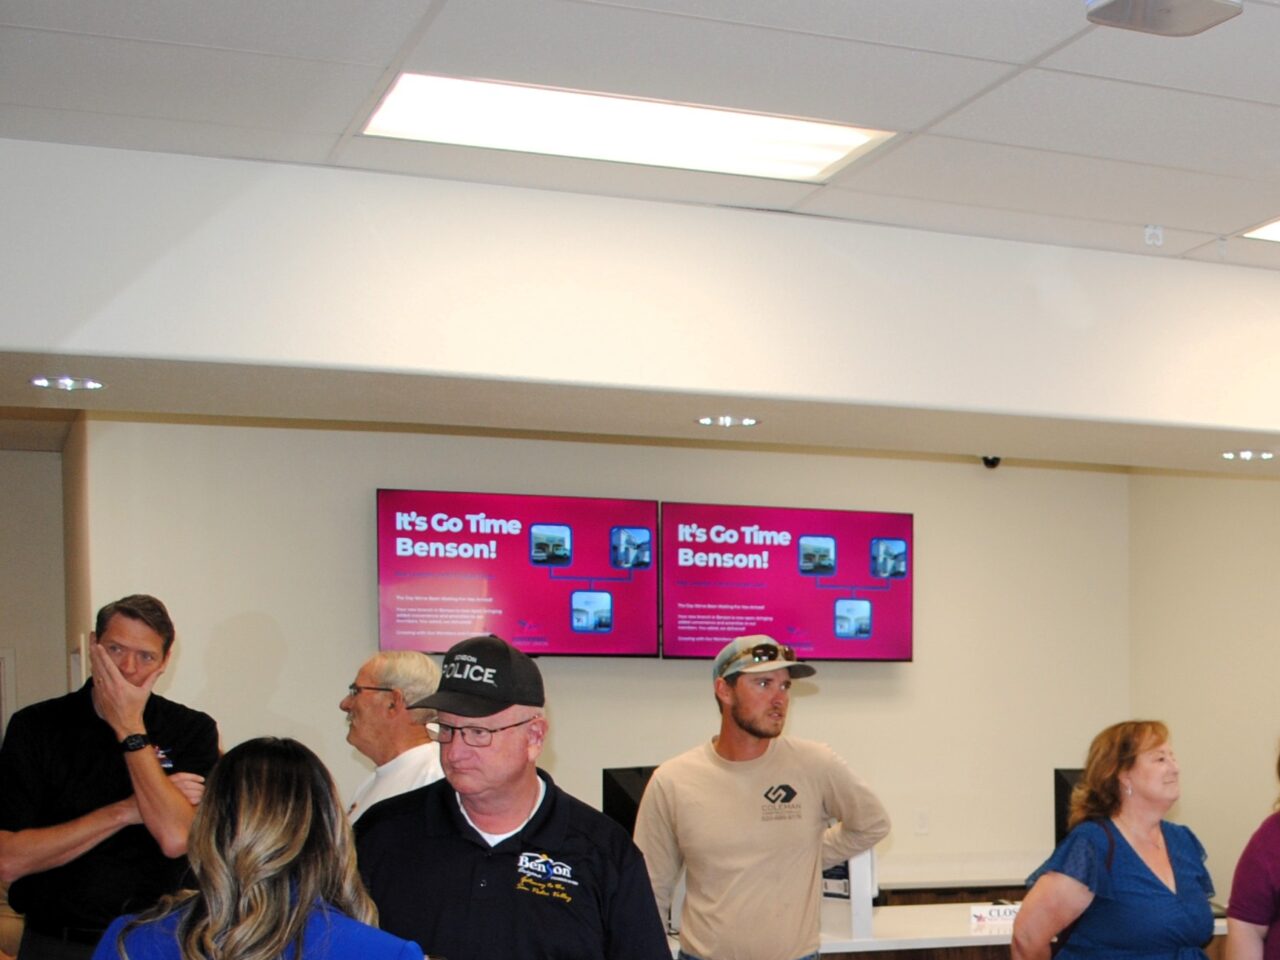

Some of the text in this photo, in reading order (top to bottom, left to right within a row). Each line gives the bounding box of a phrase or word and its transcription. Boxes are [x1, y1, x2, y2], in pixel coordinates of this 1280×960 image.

[396, 511, 522, 534] It's Go Time
[678, 523, 792, 546] It's Go Time
[396, 537, 497, 559] Benson!
[678, 548, 769, 569] Benson!
[988, 908, 1017, 918] CLOS
